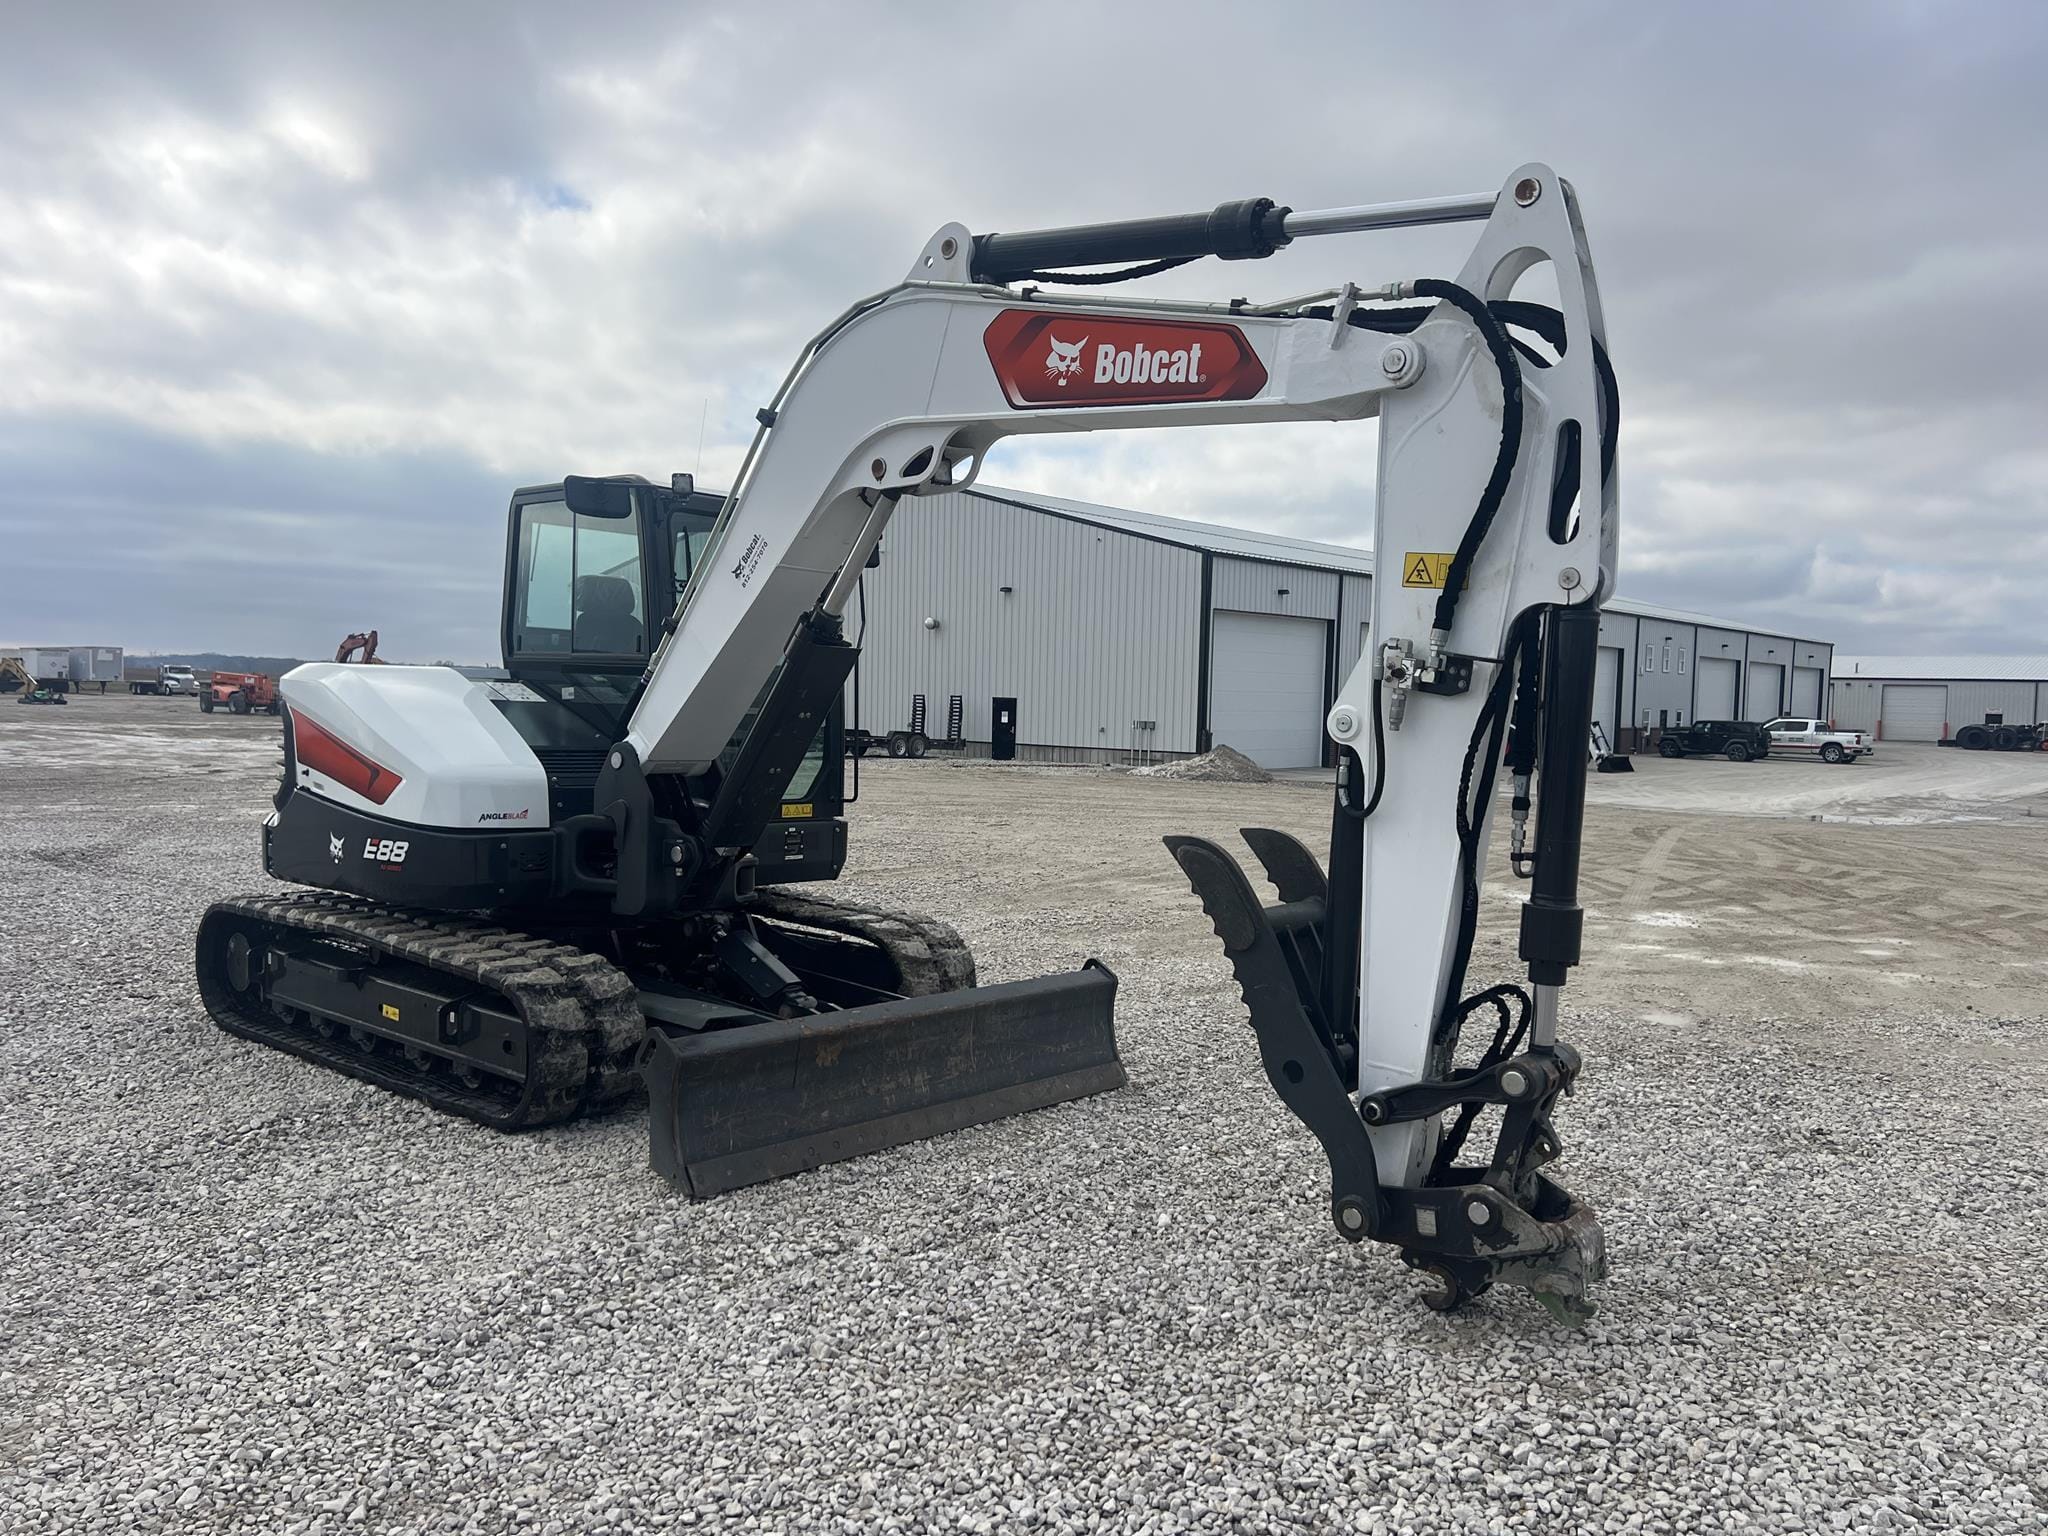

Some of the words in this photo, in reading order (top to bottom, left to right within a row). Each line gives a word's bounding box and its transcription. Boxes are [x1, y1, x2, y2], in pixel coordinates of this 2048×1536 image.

[1094, 343, 1202, 384] Bobcat
[741, 534, 760, 564] Bobcat
[363, 838, 409, 862] E88
